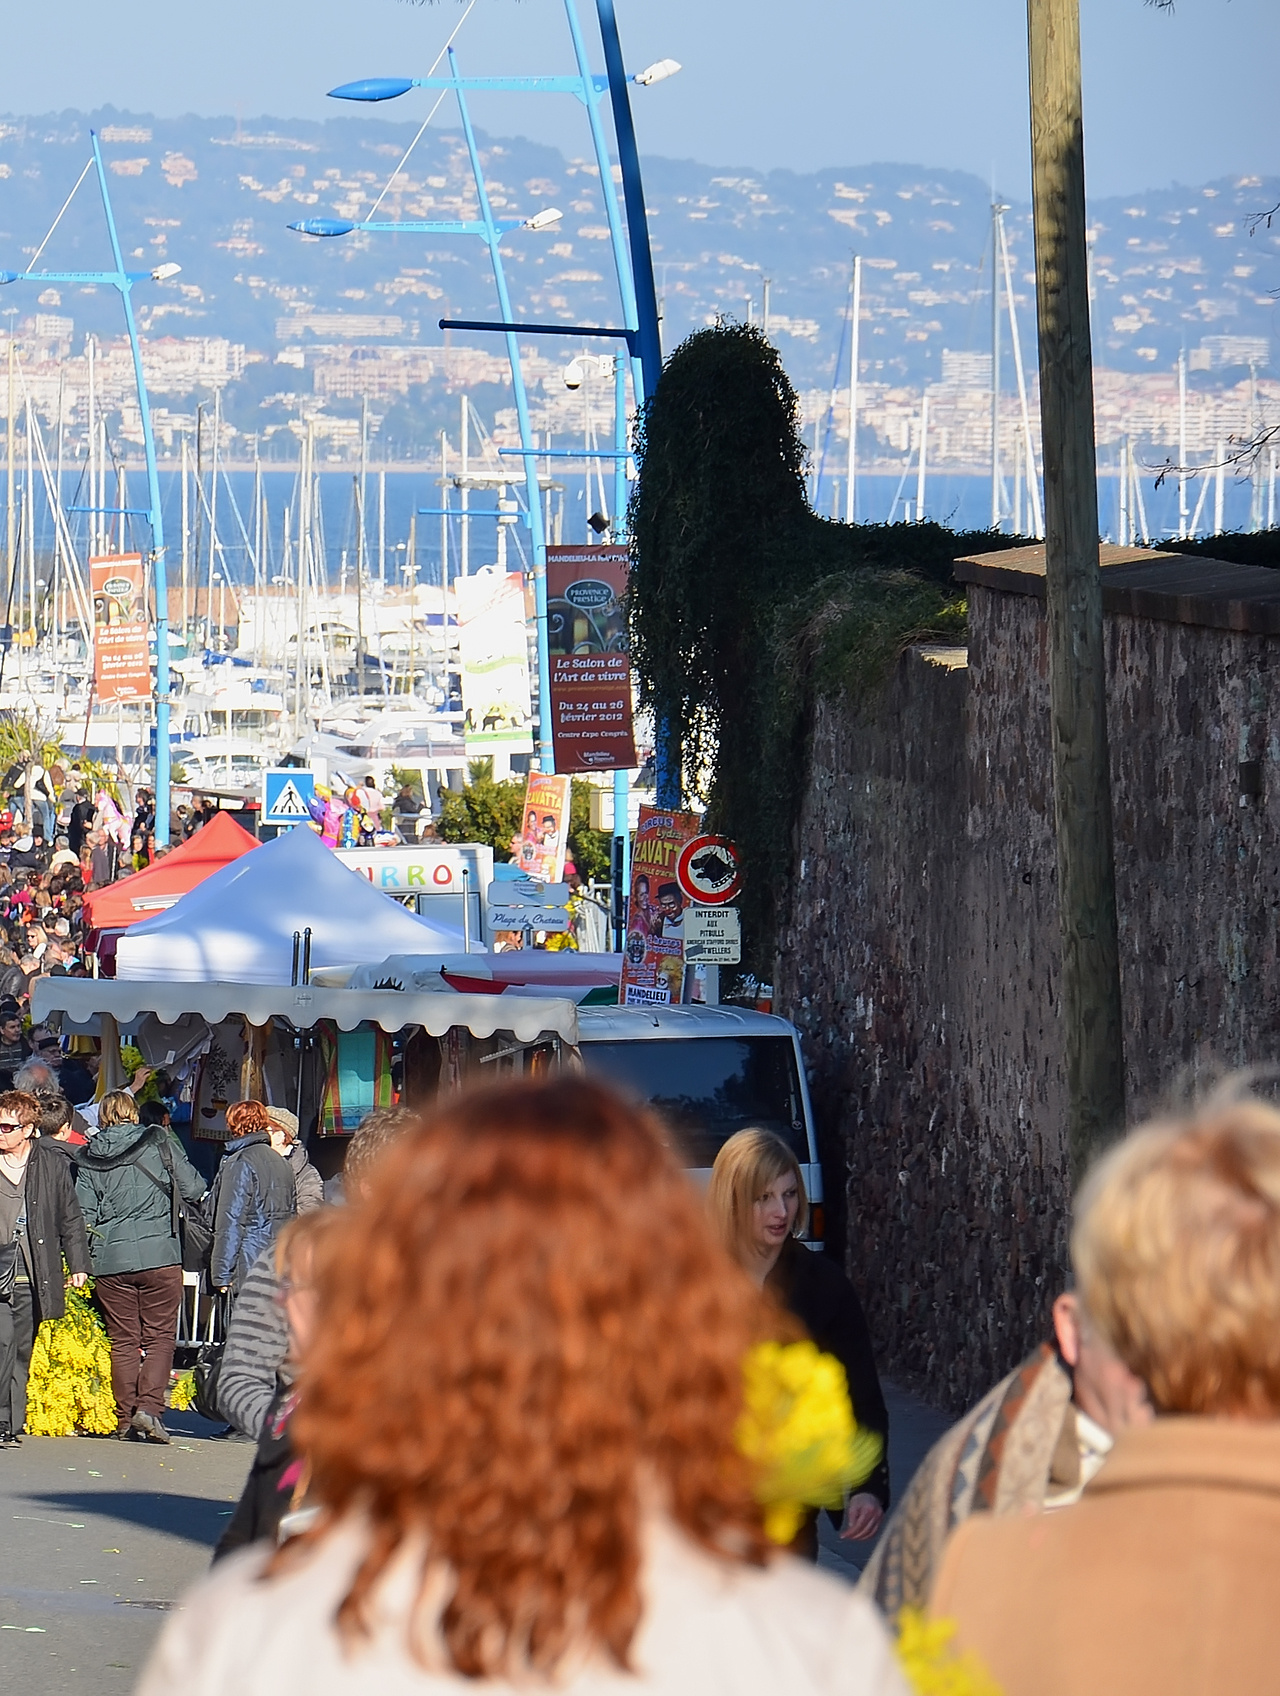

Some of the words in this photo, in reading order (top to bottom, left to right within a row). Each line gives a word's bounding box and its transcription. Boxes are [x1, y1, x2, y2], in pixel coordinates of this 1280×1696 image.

[557, 659, 570, 669] Le
[572, 658, 605, 668] Salon
[607, 658, 622, 667] de
[554, 672, 579, 682] l'Art
[580, 672, 595, 682] de
[597, 671, 627, 681] vivre
[558, 701, 574, 710] Du
[576, 702, 589, 712] 24
[591, 702, 607, 710] au
[609, 700, 624, 710] 26
[560, 712, 597, 723] février
[598, 712, 623, 721] 2012
[581, 731, 599, 739] Expo
[527, 790, 562, 809] ZAVATTA
[640, 816, 673, 834] CIRCUS
[634, 839, 682, 866] ZAVATT
[493, 913, 517, 927] Plage
[699, 929, 724, 937] PITBULLS
[654, 936, 681, 946] heures
[627, 987, 667, 1001] MANDELIEU
